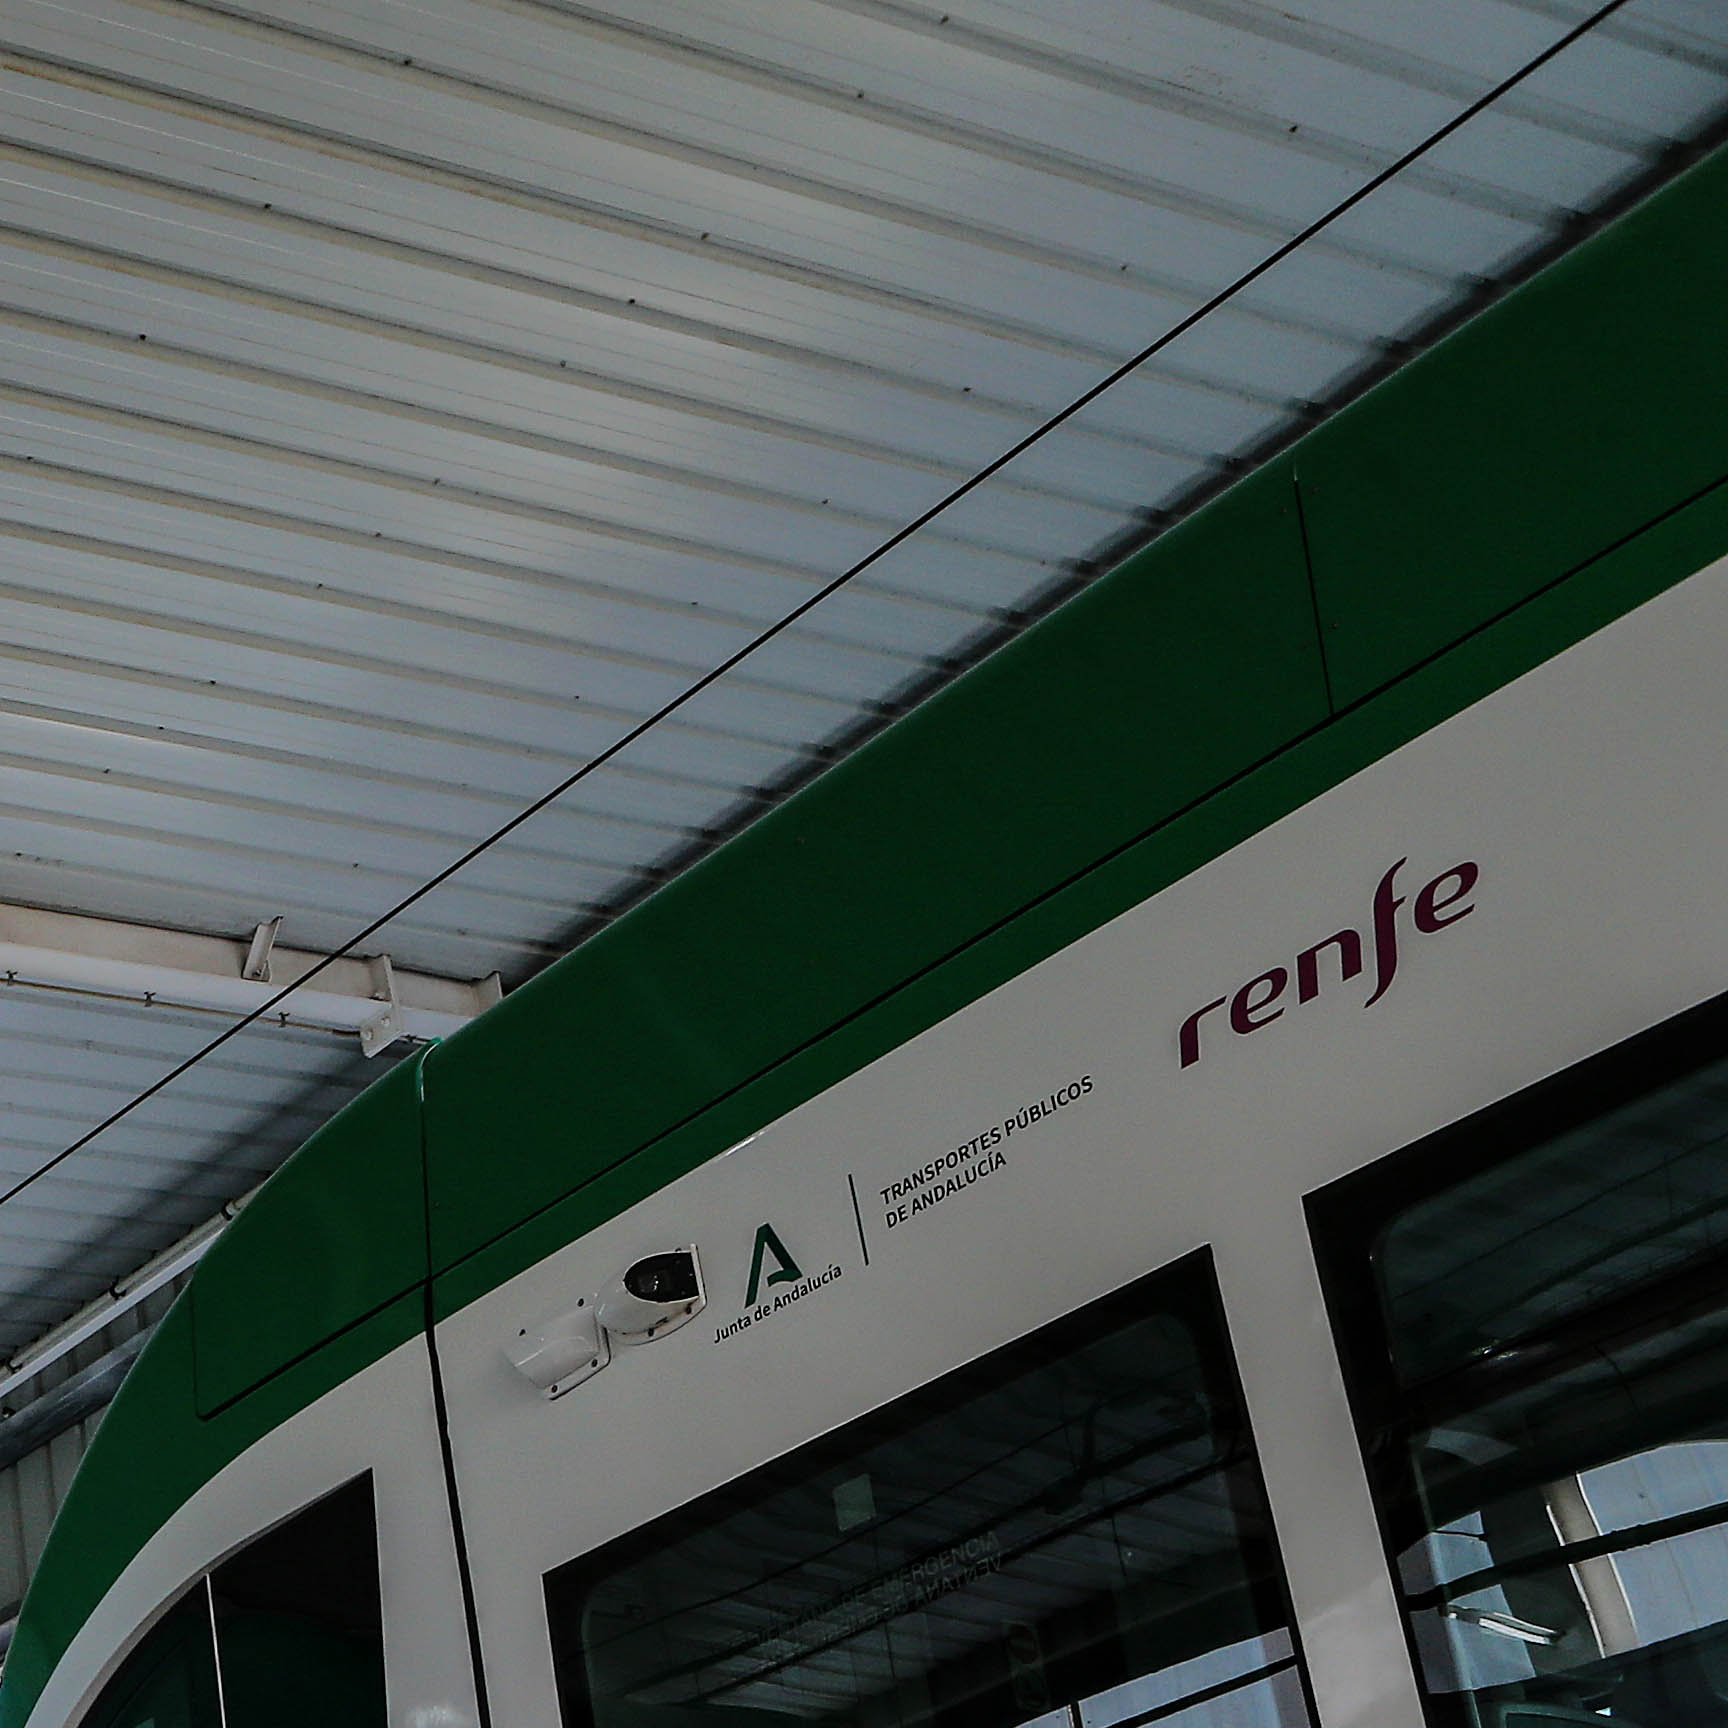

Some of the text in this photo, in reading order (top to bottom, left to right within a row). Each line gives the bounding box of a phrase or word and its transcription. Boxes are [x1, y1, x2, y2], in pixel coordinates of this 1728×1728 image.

[1179, 856, 1480, 1070] renfe
[879, 1074, 1094, 1206] TRANSPORTES PÚBLICOS
[885, 1150, 1007, 1230] DE ANDALUCÍA
[713, 1263, 843, 1345] Junta de Andalucía
